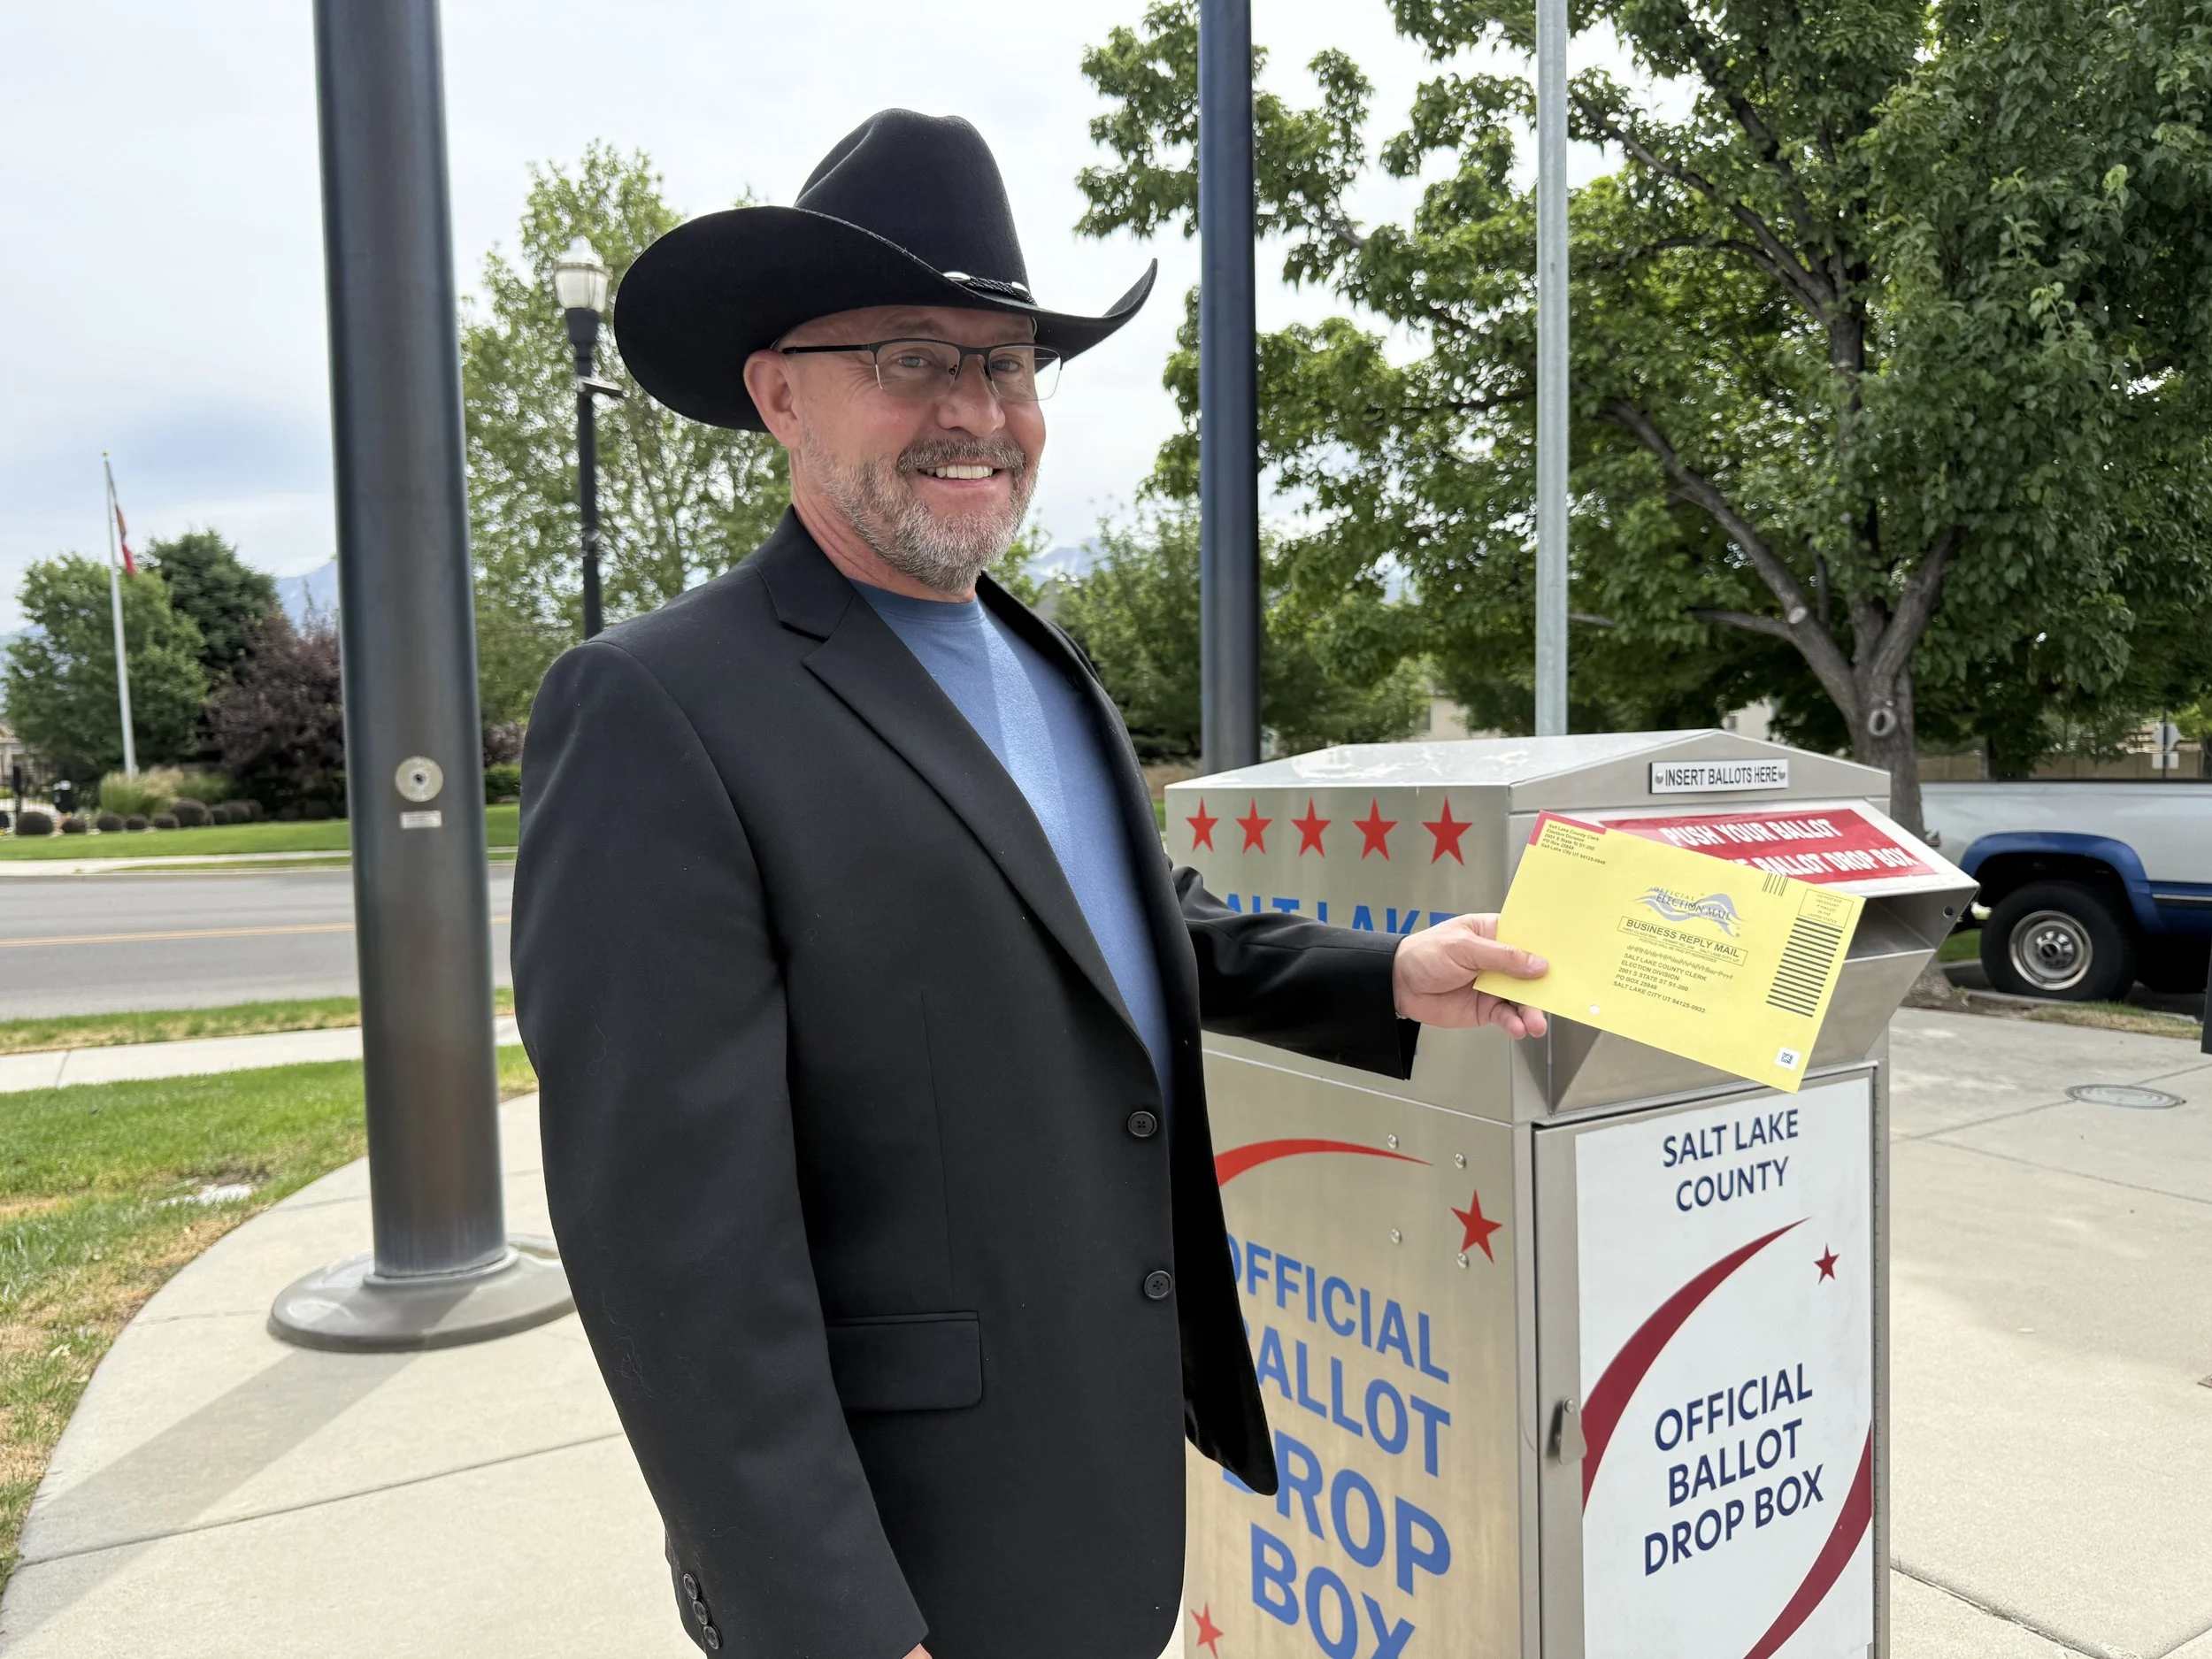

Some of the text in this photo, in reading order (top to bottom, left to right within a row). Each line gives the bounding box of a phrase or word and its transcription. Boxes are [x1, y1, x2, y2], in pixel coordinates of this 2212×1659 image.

[1664, 766, 1778, 787] INSERT BALLOTS HERE
[1659, 818, 1843, 847] PUSH YOUR BALLOT
[1751, 847, 1920, 876] BALLOT DROP BOX
[1654, 887, 1696, 902] OFFICIAL
[1656, 893, 1703, 913] ELECTION
[1706, 907, 1732, 920] MAIL
[1317, 901, 1462, 935] AK
[1626, 919, 1740, 956] BUSINESS REPLY MAIL
[1621, 960, 1679, 980] ELECTION DIVISION
[1639, 972, 1658, 982] STATE
[1640, 957, 1657, 966] LAKE
[1658, 963, 1684, 974] COUNTY
[1685, 971, 1707, 981] CLERK
[1613, 980, 1628, 989] SALT
[1629, 986, 1646, 995] LAKE
[1640, 981, 1657, 990] 25848
[1663, 1108, 1799, 1168] SALT LAKE
[1676, 1156, 1789, 1212] COUNTY
[1240, 1317, 1451, 1479] ALLOT
[1655, 1363, 1813, 1452] OFFICIAL
[1669, 1417, 1802, 1508] BALLOT
[1223, 1428, 1451, 1597] ROP
[1645, 1463, 1824, 1577] DROP BOX
